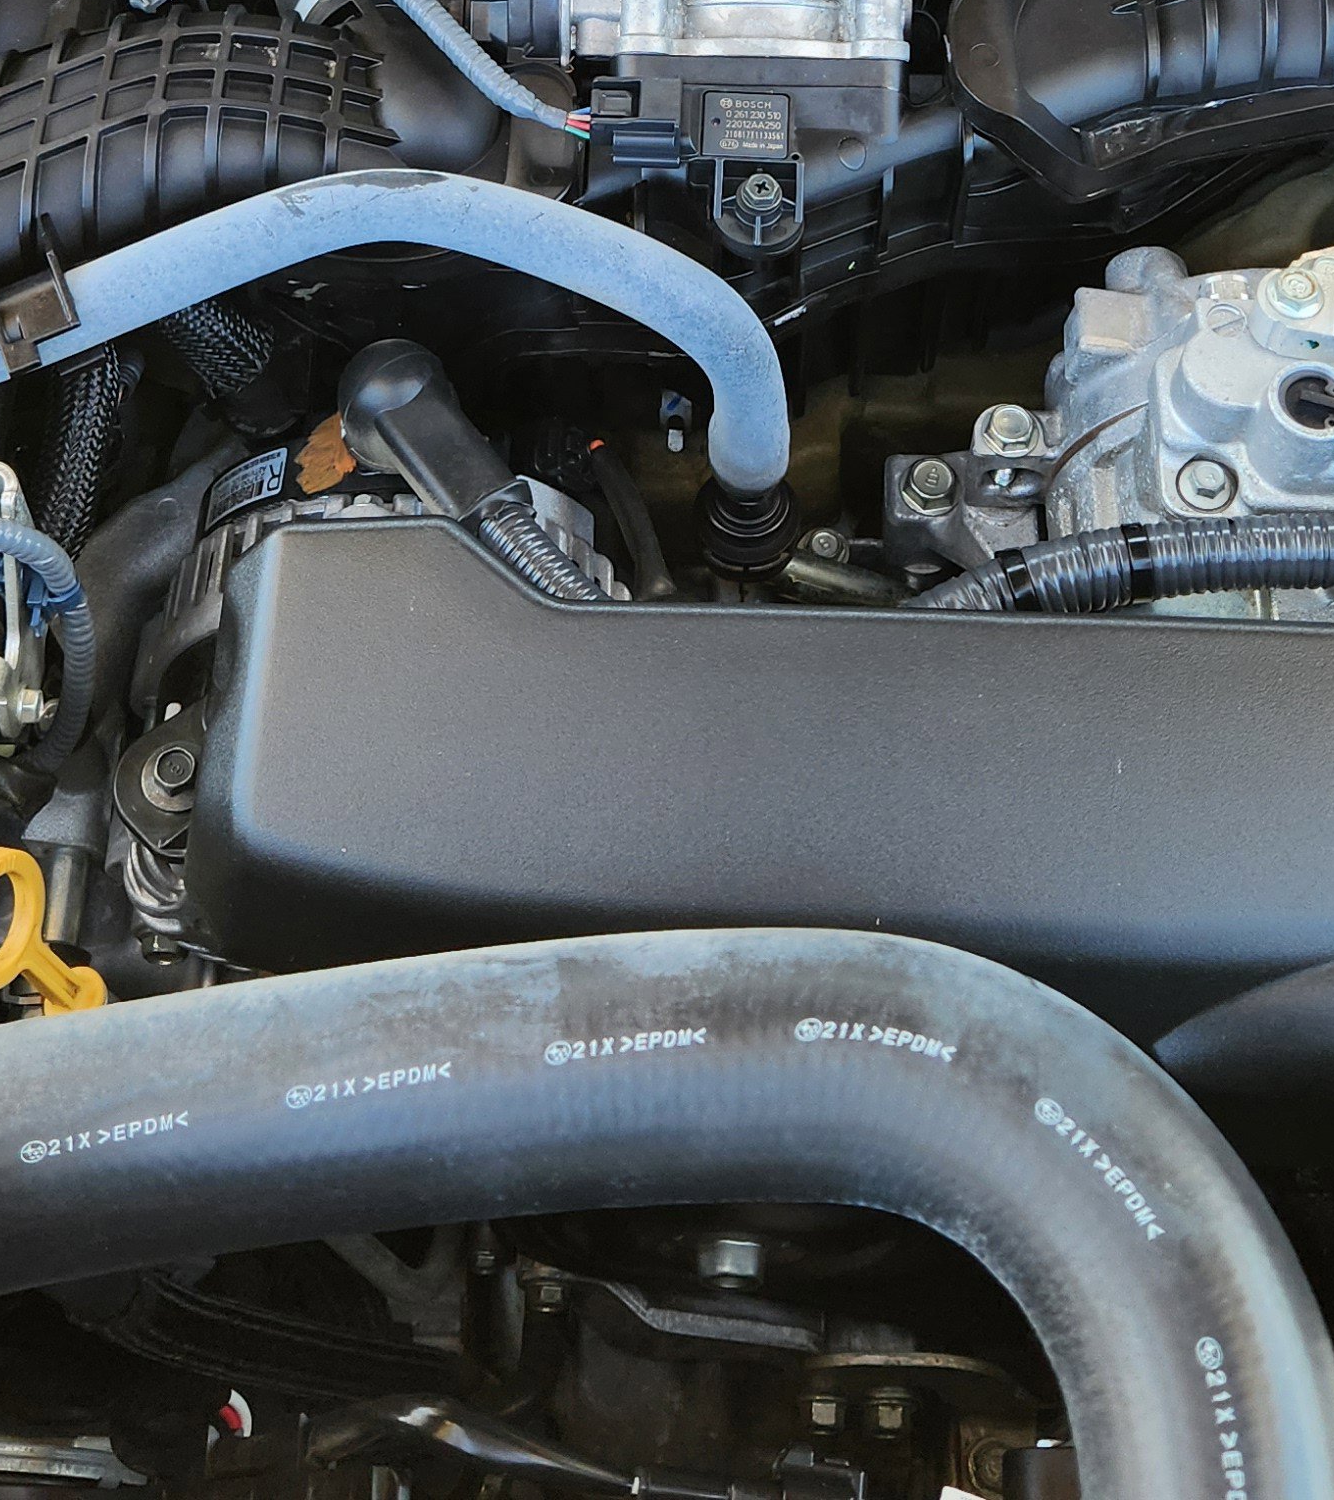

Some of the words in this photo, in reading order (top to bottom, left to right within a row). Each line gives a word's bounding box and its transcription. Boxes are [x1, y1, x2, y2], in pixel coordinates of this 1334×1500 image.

[735, 100, 772, 109] BOSCH
[734, 111, 748, 119] 261
[750, 111, 765, 119] 230
[767, 112, 782, 120] 510
[726, 120, 782, 130] 22012AA250
[267, 461, 283, 491] R
